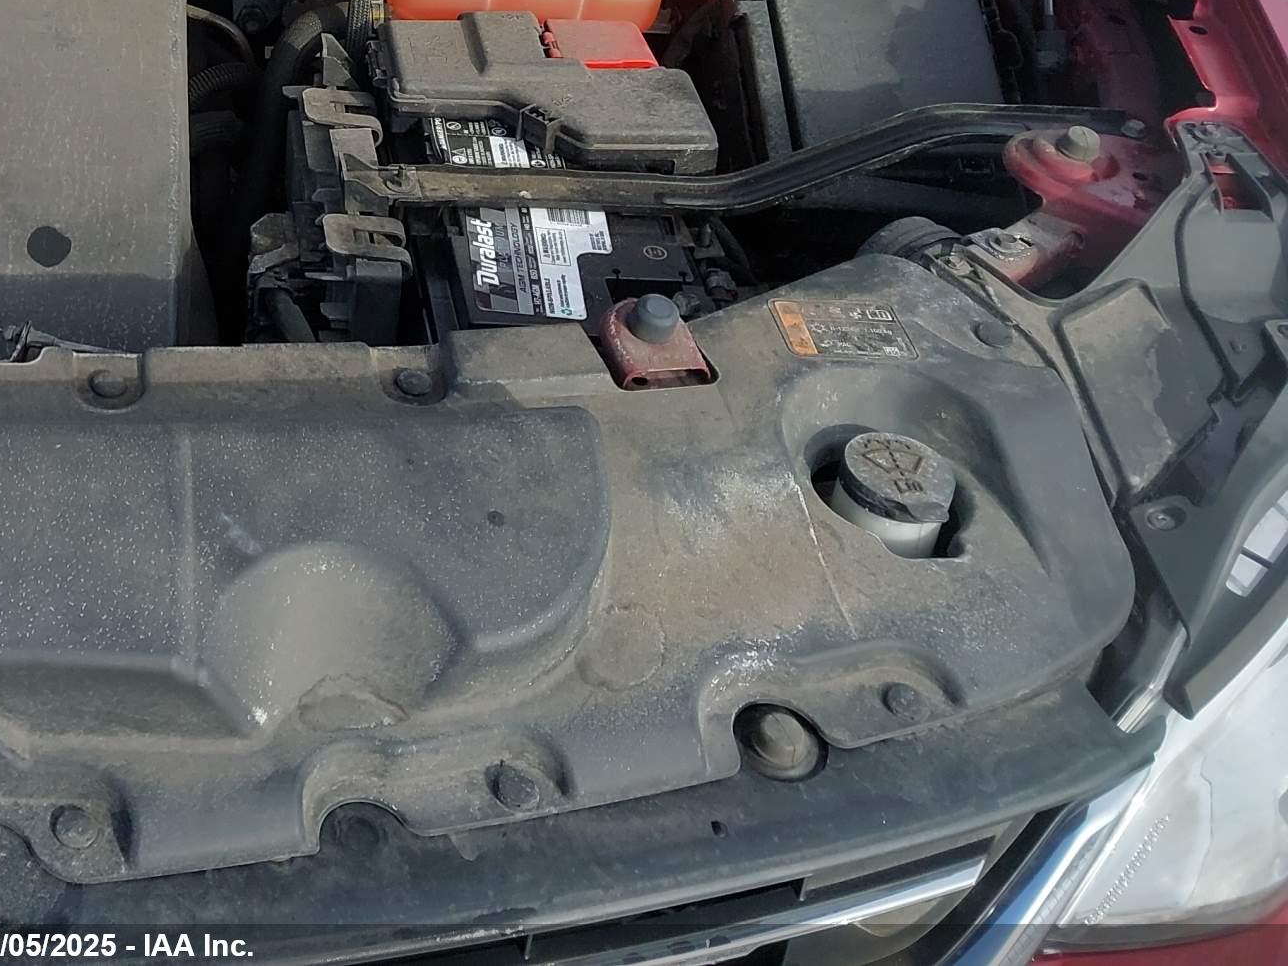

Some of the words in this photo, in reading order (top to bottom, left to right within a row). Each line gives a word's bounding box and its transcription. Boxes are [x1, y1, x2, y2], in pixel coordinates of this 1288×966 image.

[470, 217, 500, 287] Duralast
[511, 221, 525, 273] TECHNOLOGY
[517, 274, 527, 294] AGM
